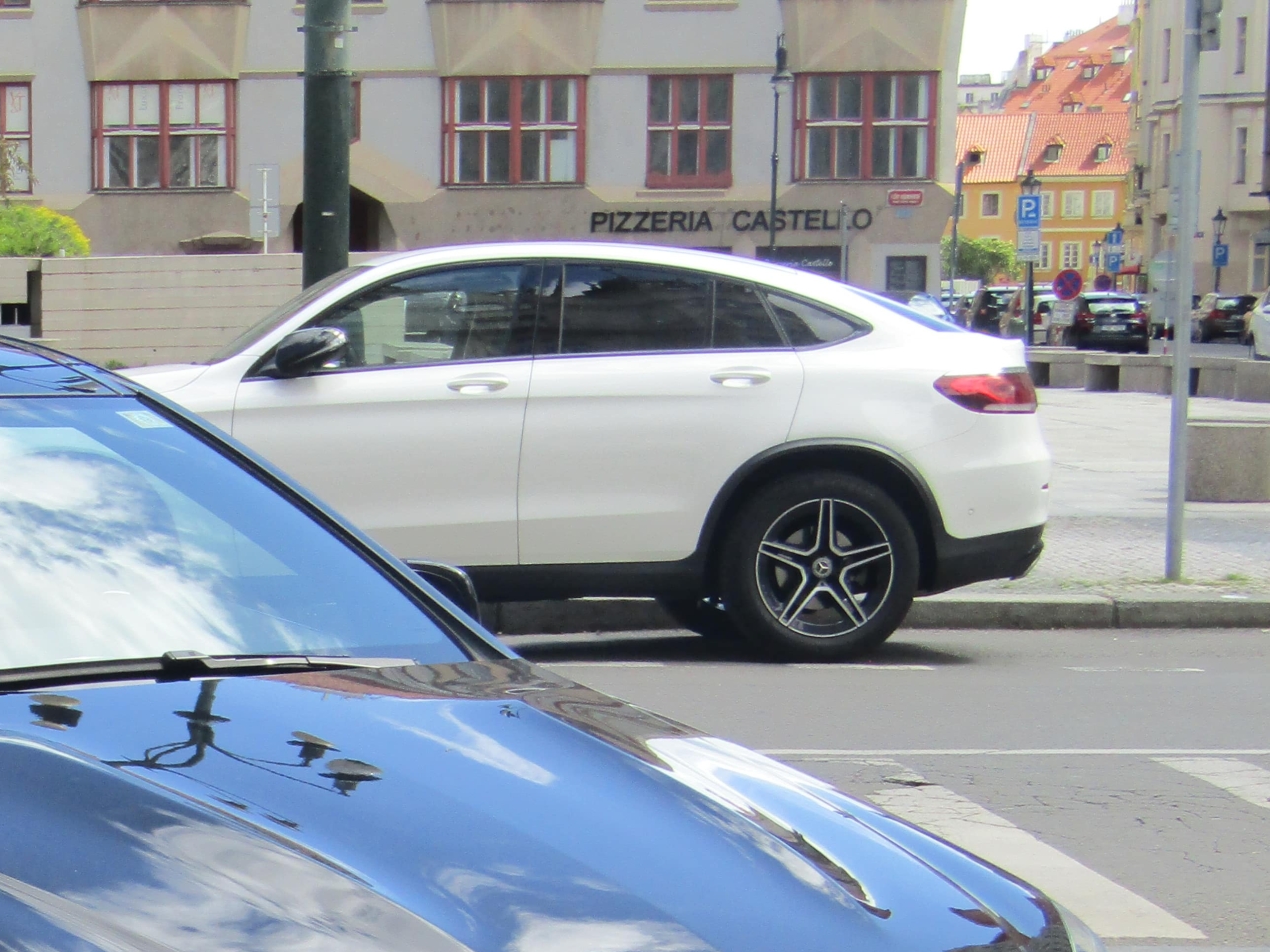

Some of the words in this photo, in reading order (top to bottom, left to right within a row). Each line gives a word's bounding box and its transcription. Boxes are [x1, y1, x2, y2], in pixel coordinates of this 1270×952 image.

[1022, 199, 1036, 218] P
[590, 211, 713, 233] PIZZERIA
[1109, 255, 1118, 266] P
[1215, 247, 1225, 259] P
